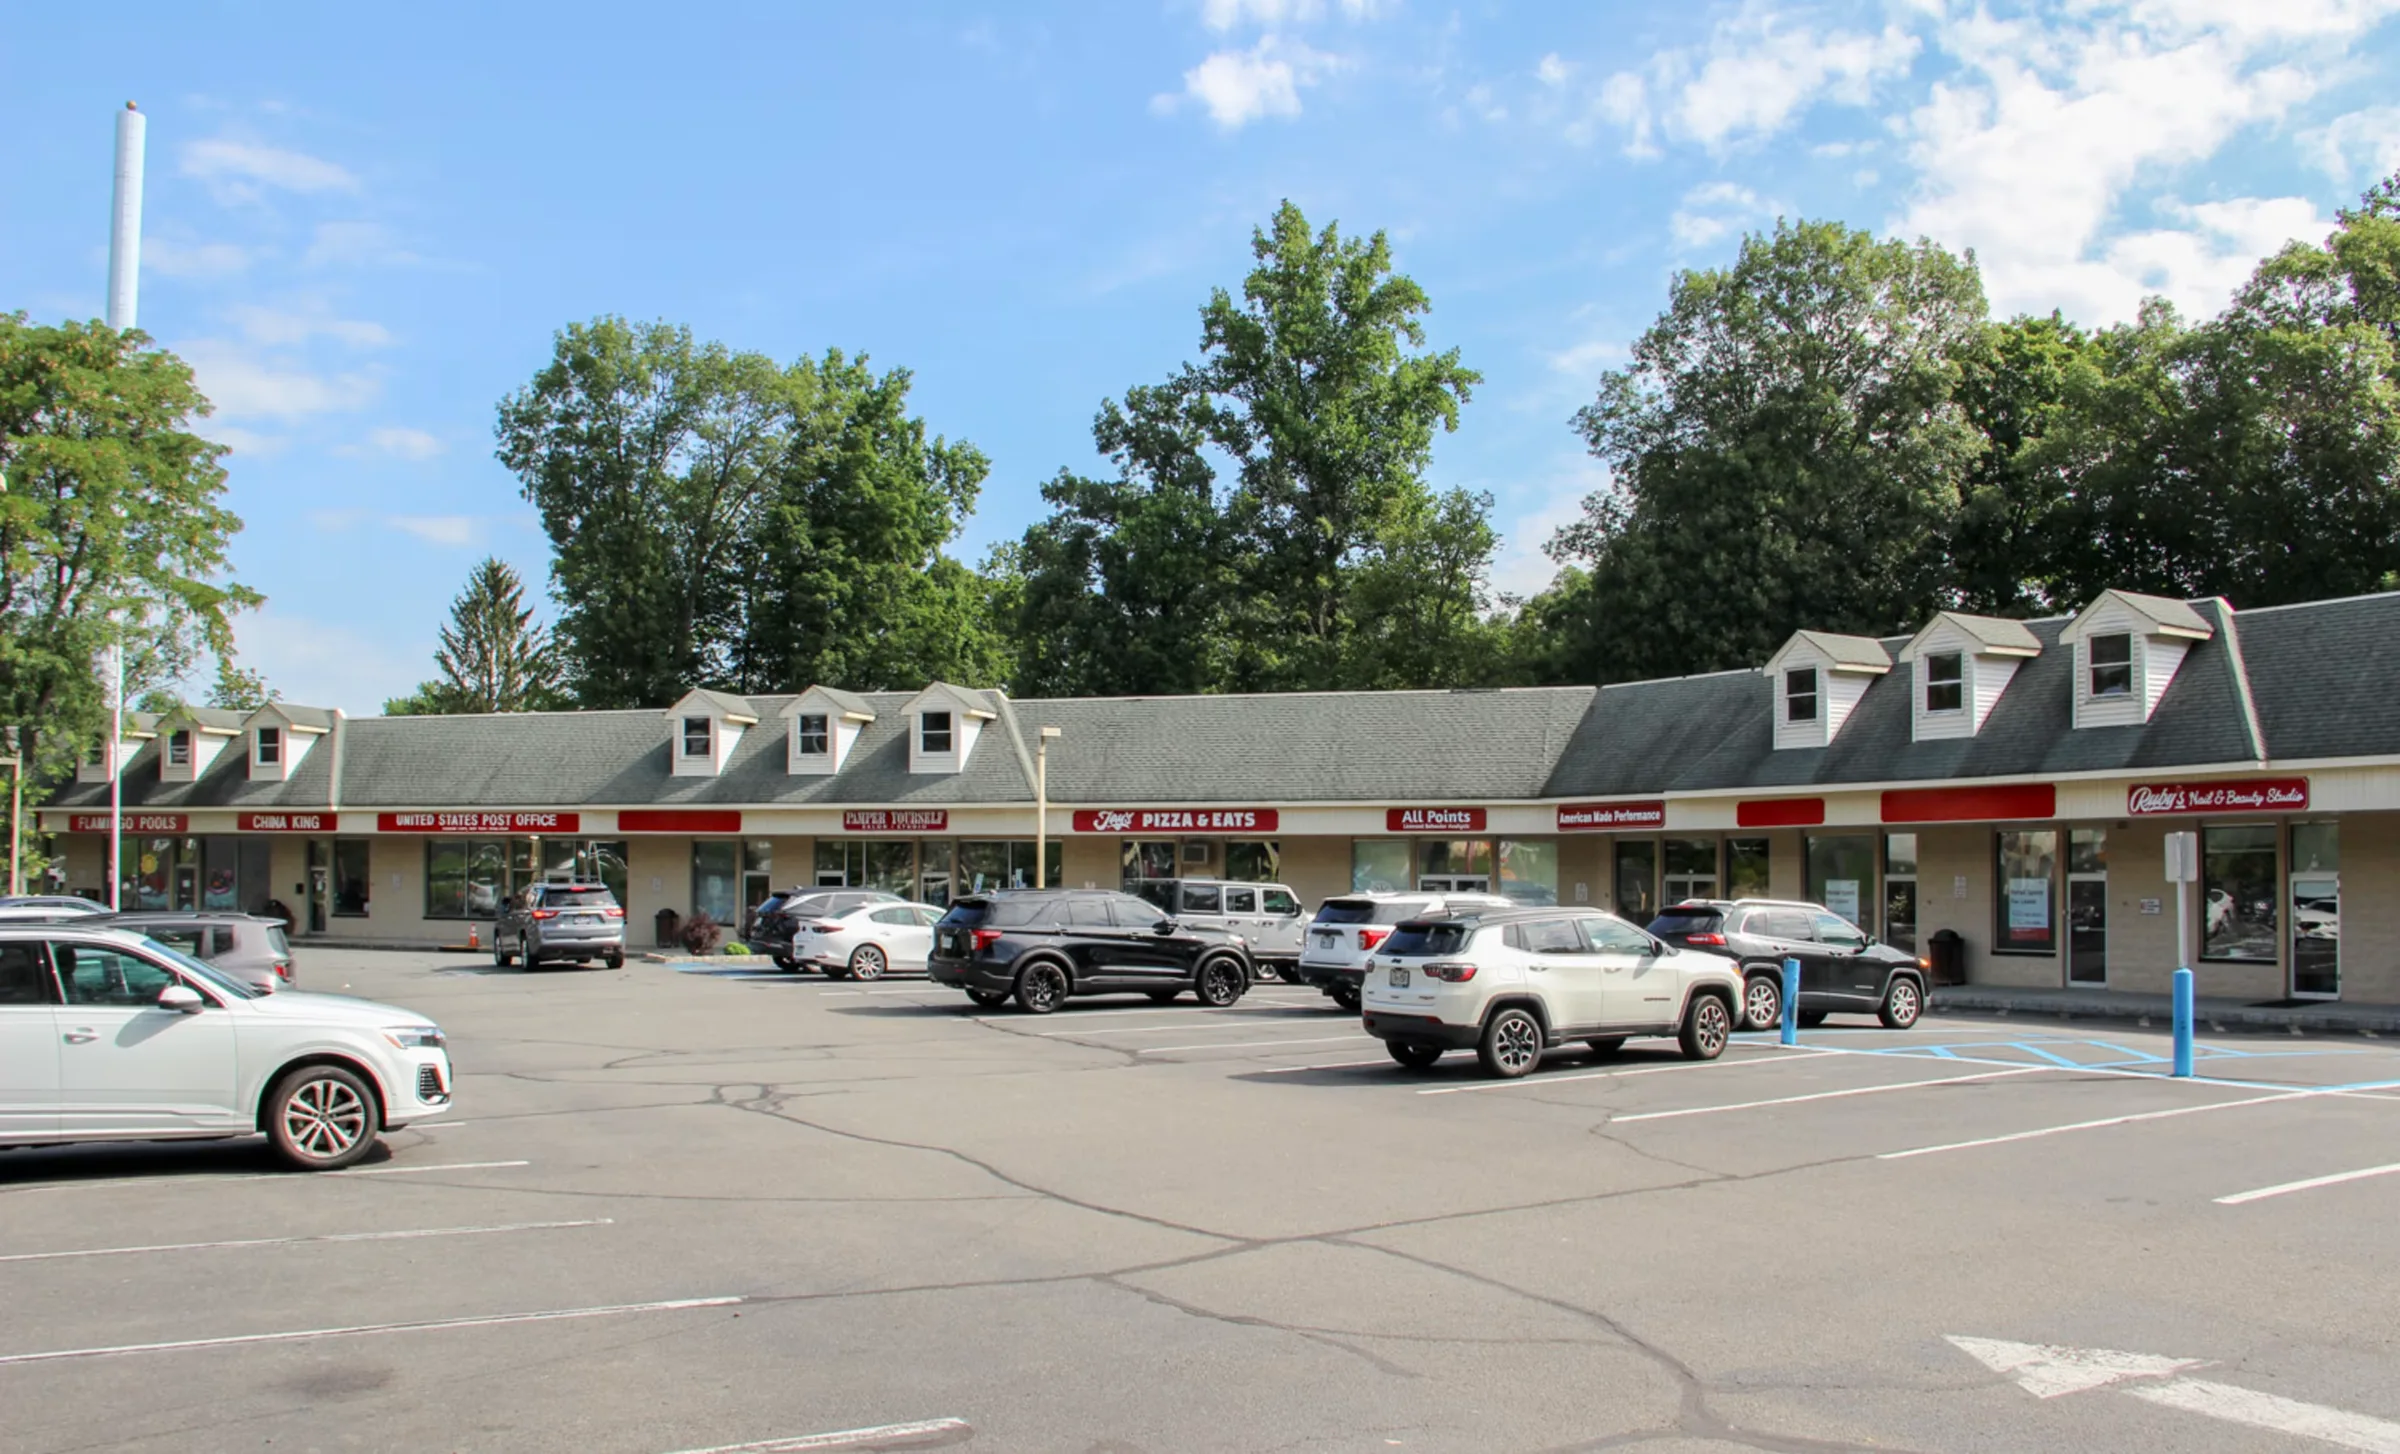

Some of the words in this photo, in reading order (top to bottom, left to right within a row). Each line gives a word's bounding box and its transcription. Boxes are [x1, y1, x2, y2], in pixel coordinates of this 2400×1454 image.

[2129, 787, 2186, 812] Ruby's
[2188, 790, 2213, 806] Nail
[2214, 790, 2224, 804] &
[2226, 789, 2264, 806] Beauty
[2266, 787, 2304, 803] Studio
[78, 816, 134, 829] FLAMIGO
[140, 816, 177, 829] POOLS
[252, 815, 287, 829] CHINA
[292, 815, 319, 829] KING
[396, 813, 434, 826] UNITED
[438, 813, 479, 826] STATES
[482, 814, 511, 826] POST
[516, 813, 557, 826] OFFICE
[846, 811, 886, 824] PAMPER
[891, 811, 944, 824] YOURSELF
[1142, 813, 1193, 827] PIZZA
[1197, 814, 1208, 827] &
[1212, 812, 1256, 827] EATS
[1402, 810, 1424, 823] All
[1427, 809, 1471, 823] Points
[1560, 812, 1592, 824] American
[1593, 811, 1612, 823] Made
[1614, 810, 1660, 822] Performance
